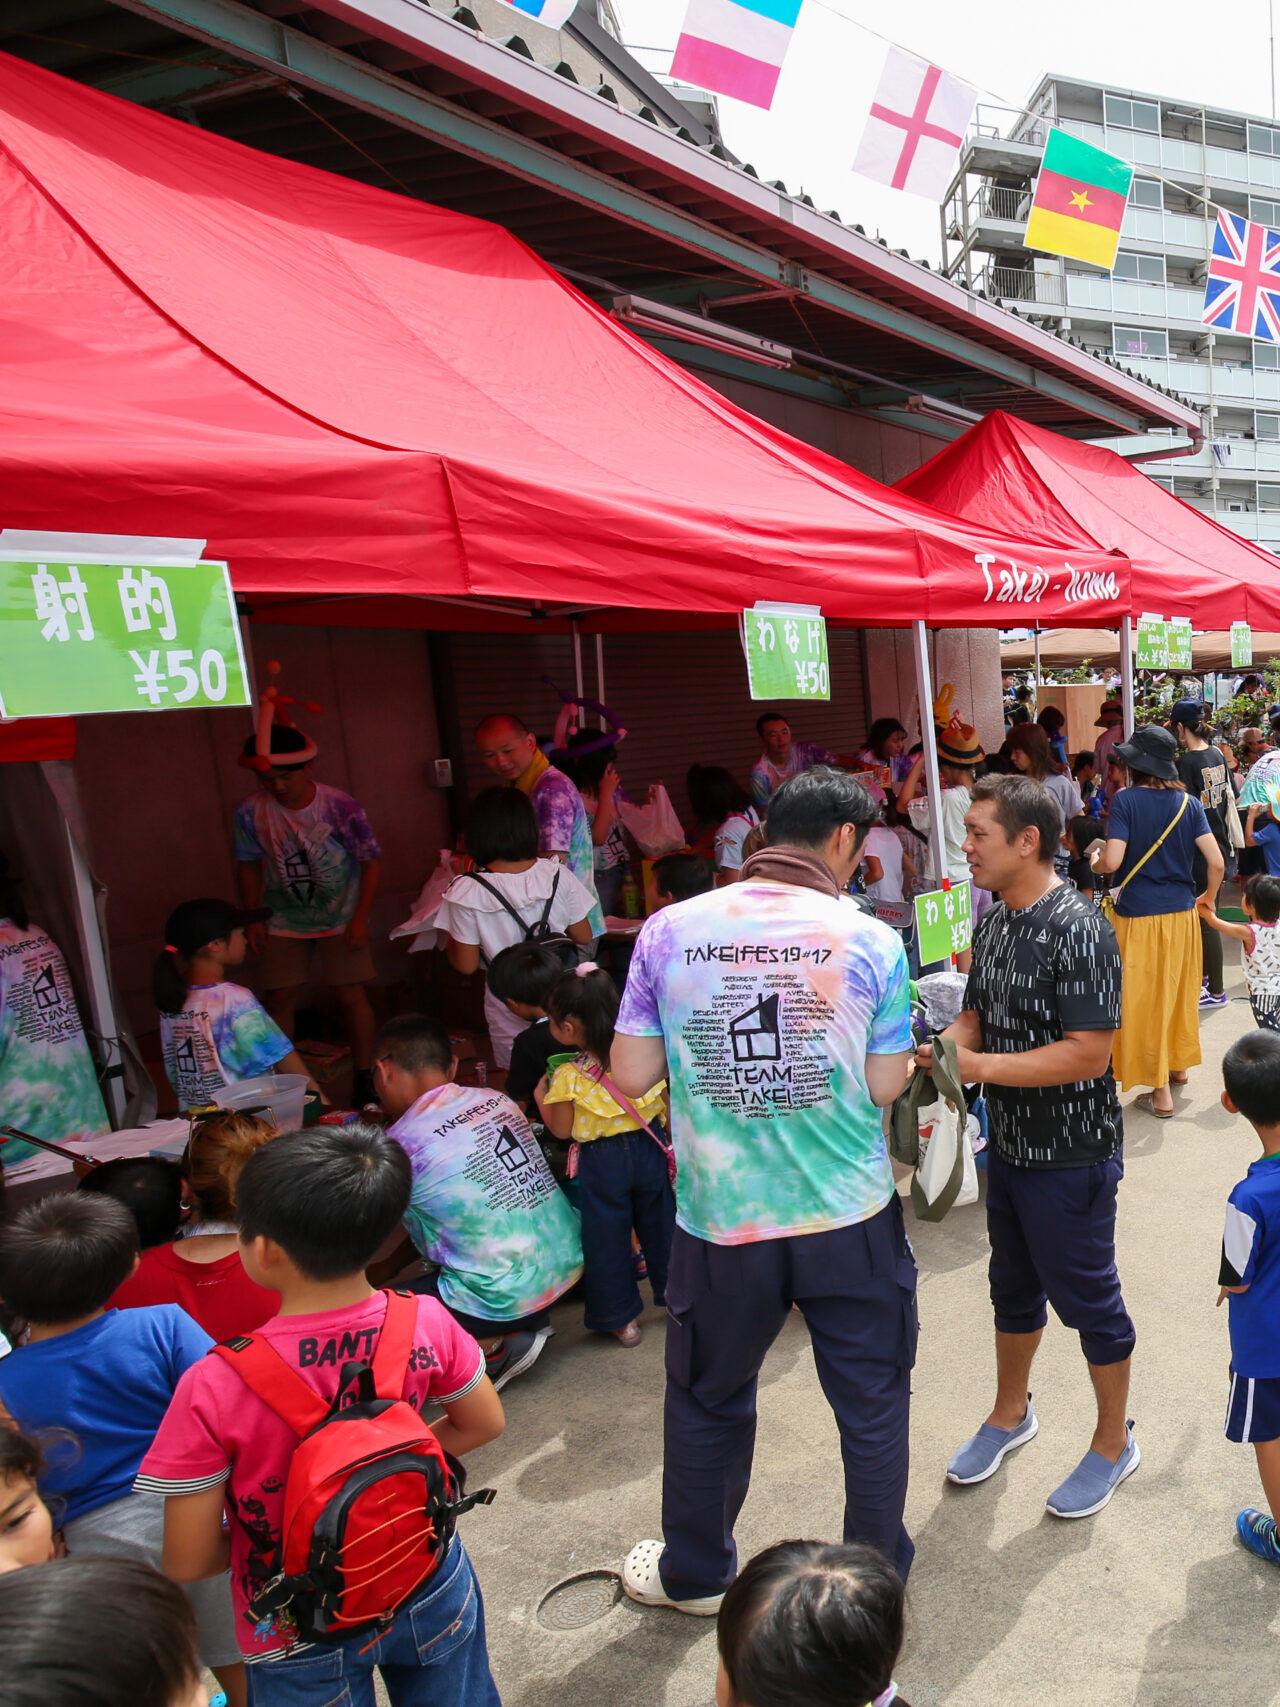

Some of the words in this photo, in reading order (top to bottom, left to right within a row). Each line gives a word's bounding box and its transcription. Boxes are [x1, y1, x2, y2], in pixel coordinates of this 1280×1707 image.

[974, 553, 1050, 604] Takei
[1064, 562, 1121, 602] home
[31, 564, 178, 642] 射的
[757, 617, 821, 656] わなげ
[128, 648, 227, 704] ¥50
[794, 660, 828, 695] ¥50
[924, 887, 968, 927] わなげ
[951, 917, 971, 951] ¥50
[729, 1064, 793, 1085] TEAM
[735, 1086, 793, 1106] TAKEI
[508, 1163, 542, 1188] TEAM
[518, 1178, 547, 1202] TAKEI
[298, 1325, 384, 1368] BANT
